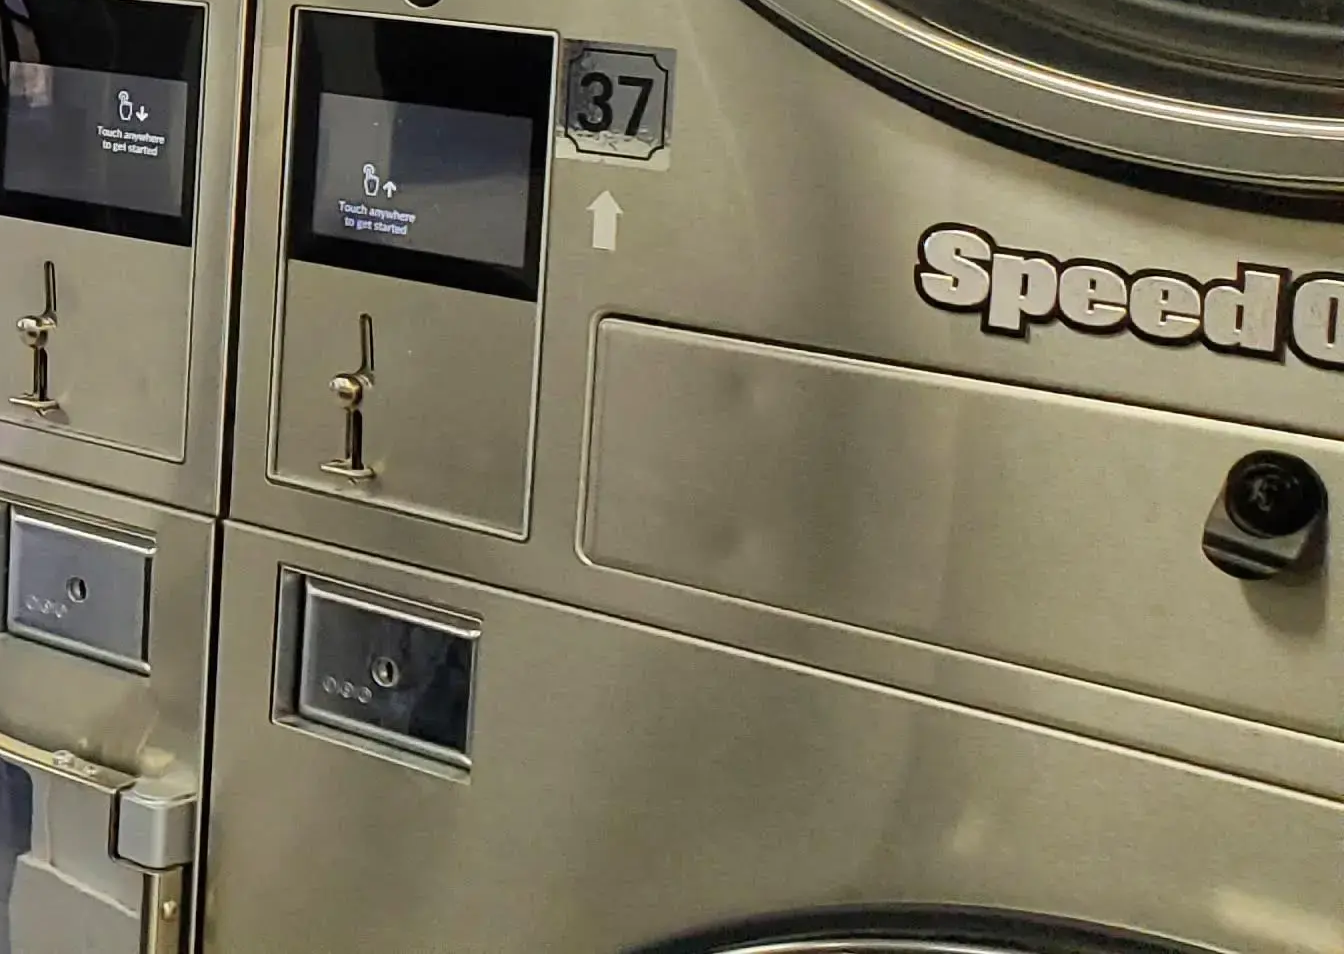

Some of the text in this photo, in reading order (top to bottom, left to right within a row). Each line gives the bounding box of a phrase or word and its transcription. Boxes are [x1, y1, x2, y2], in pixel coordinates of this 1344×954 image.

[577, 71, 654, 137] 37
[97, 126, 123, 138] Touch
[102, 139, 112, 149] to
[338, 200, 416, 223] Touch anywhere
[344, 216, 354, 226] to
[373, 222, 408, 235] started
[914, 222, 1291, 365] Speed
